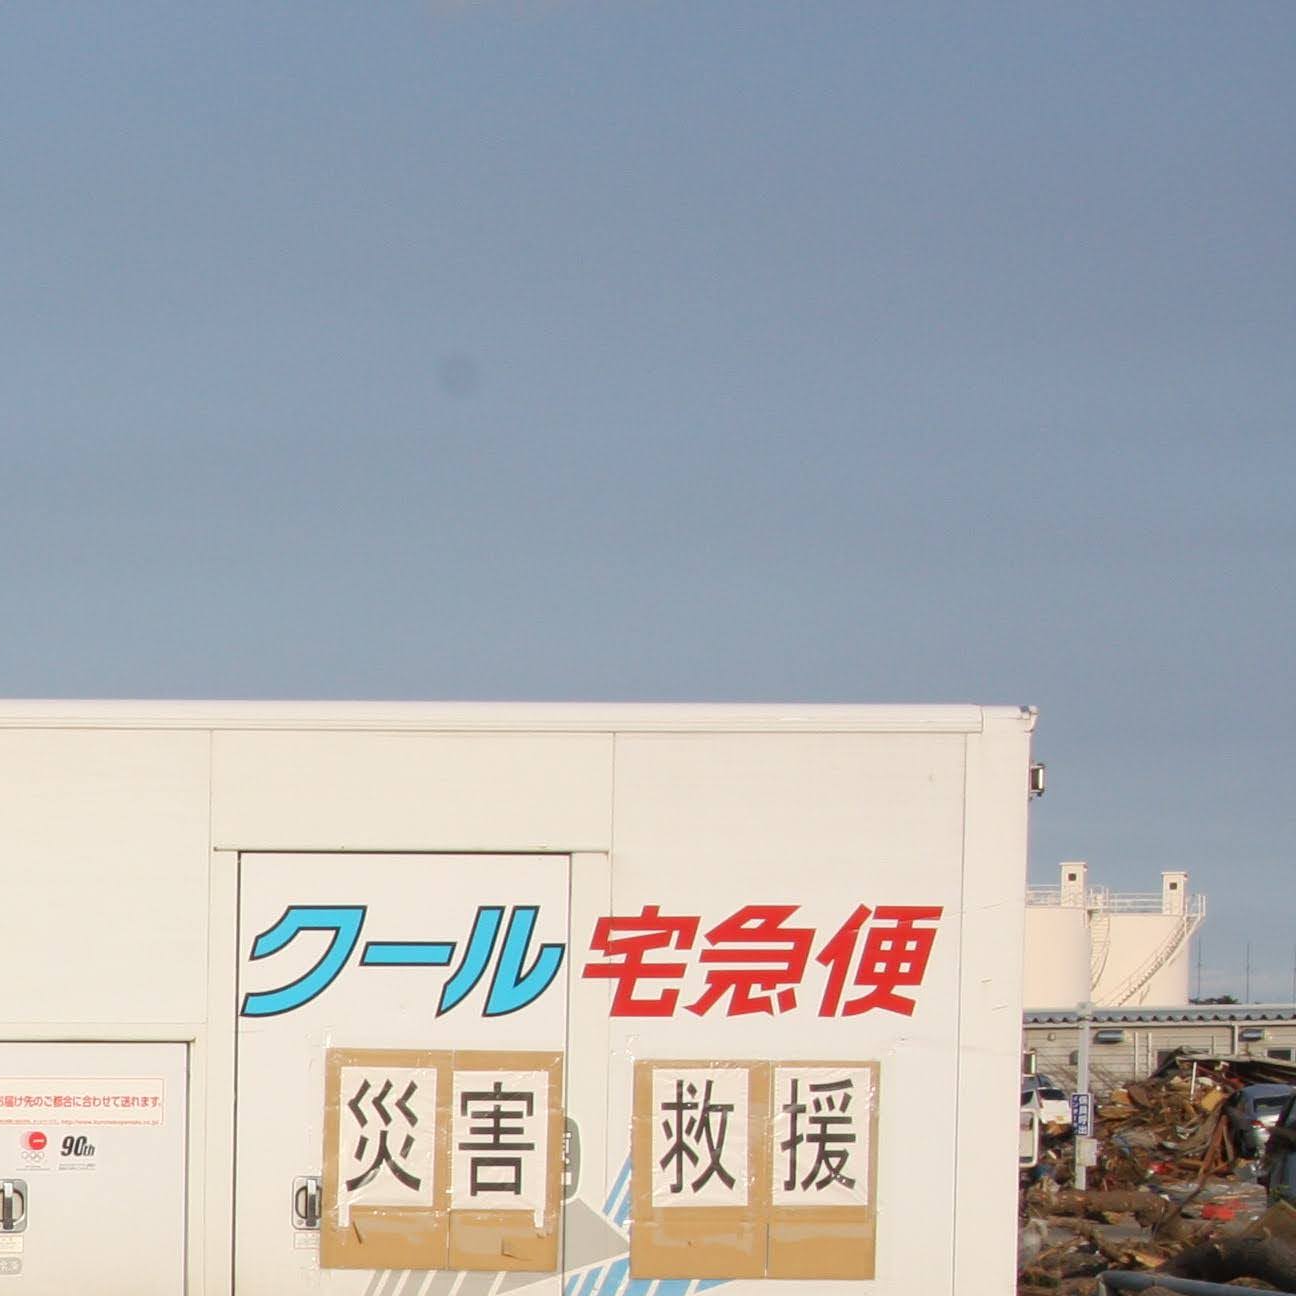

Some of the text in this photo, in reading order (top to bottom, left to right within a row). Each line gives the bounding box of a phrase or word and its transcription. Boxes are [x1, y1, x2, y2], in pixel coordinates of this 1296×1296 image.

[60, 1136, 96, 1157] 90th
[348, 1080, 535, 1196] 災害
[662, 1079, 856, 1193] 救援
